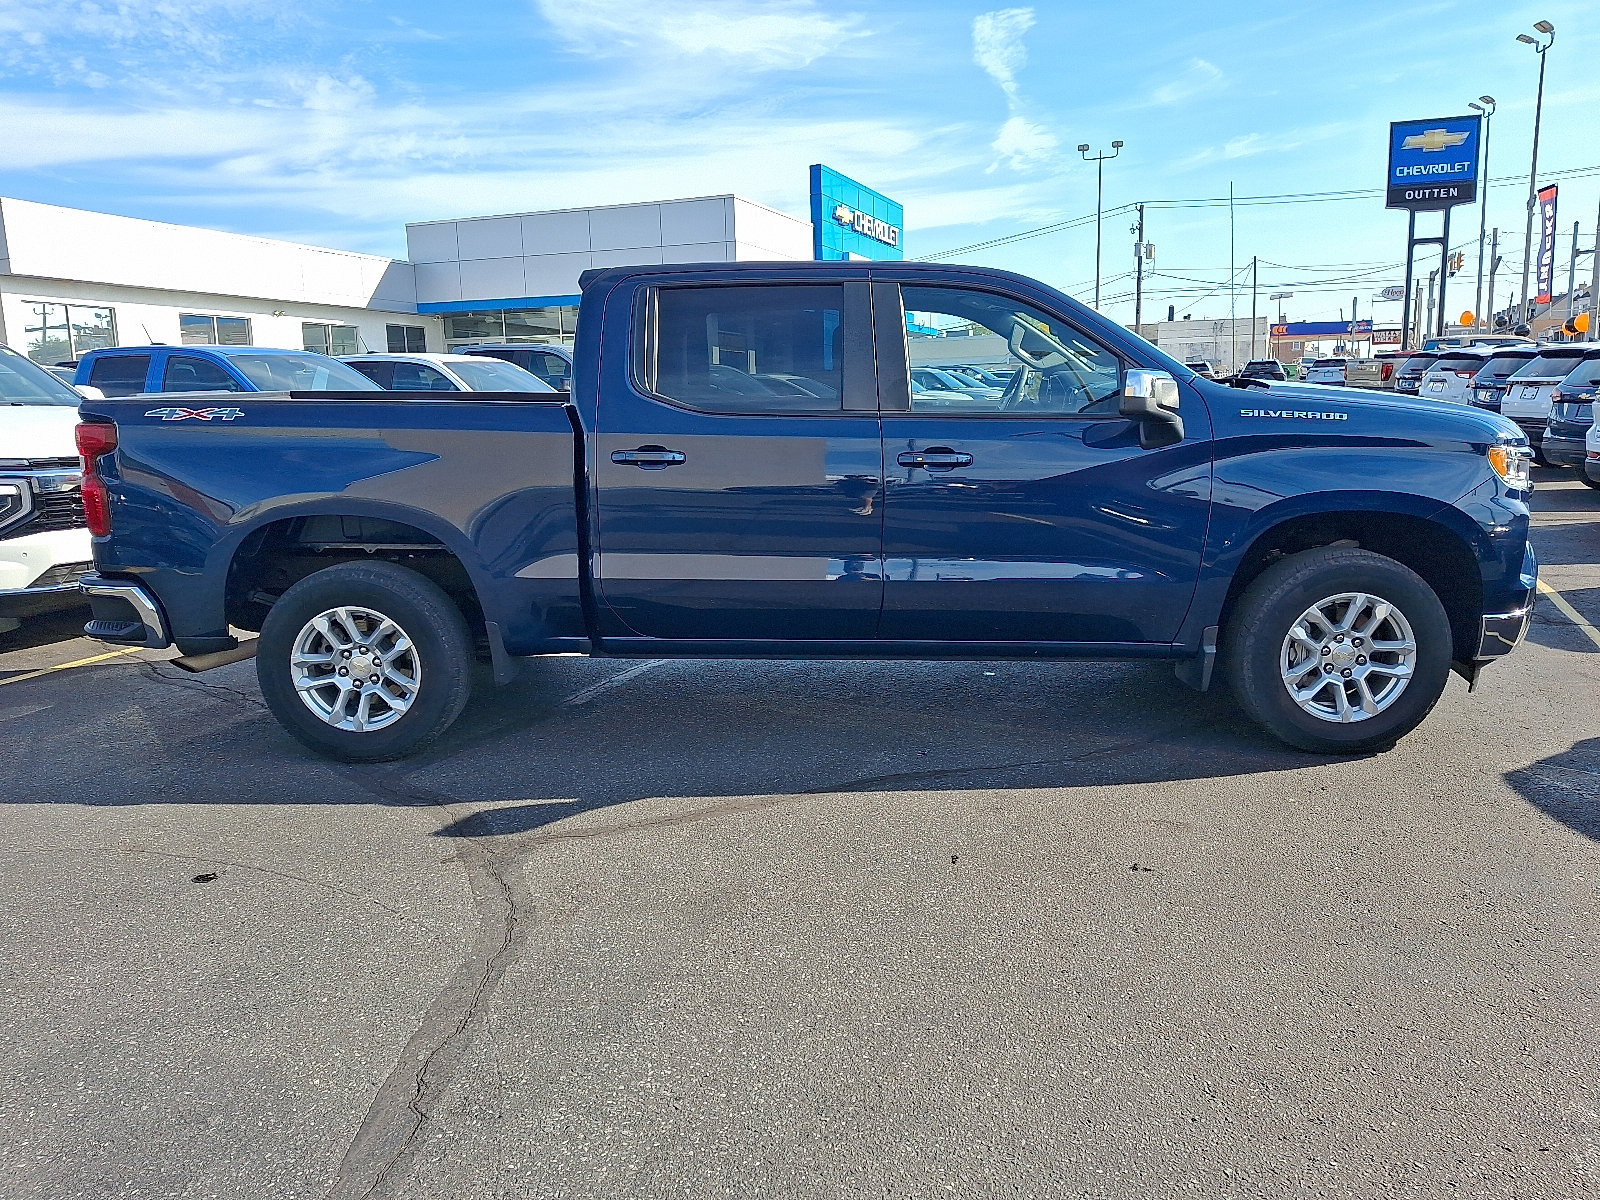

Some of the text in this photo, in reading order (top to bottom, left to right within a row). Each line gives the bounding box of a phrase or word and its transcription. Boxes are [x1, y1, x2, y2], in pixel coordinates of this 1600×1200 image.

[1396, 162, 1470, 177] CHEVROLET
[1405, 187, 1458, 200] OUTTEN
[853, 209, 899, 247] CHEVROLET
[1240, 409, 1348, 421] SILVERADO
